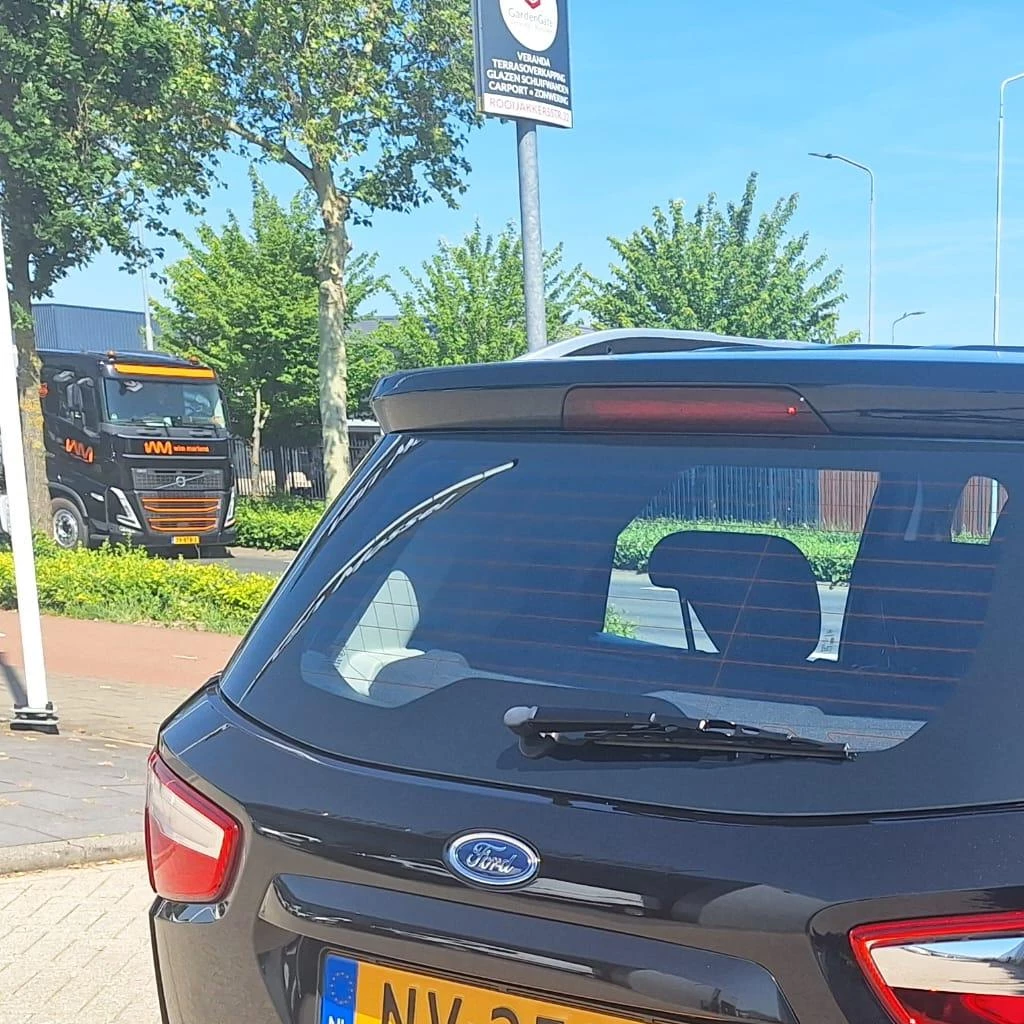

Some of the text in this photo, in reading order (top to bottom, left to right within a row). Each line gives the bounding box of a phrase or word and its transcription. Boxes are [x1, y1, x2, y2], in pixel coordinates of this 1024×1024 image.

[517, 51, 551, 67] VERANDA
[486, 69, 521, 83] GLAZEN
[488, 81, 528, 96] CARPORT
[467, 842, 517, 874] Ford
